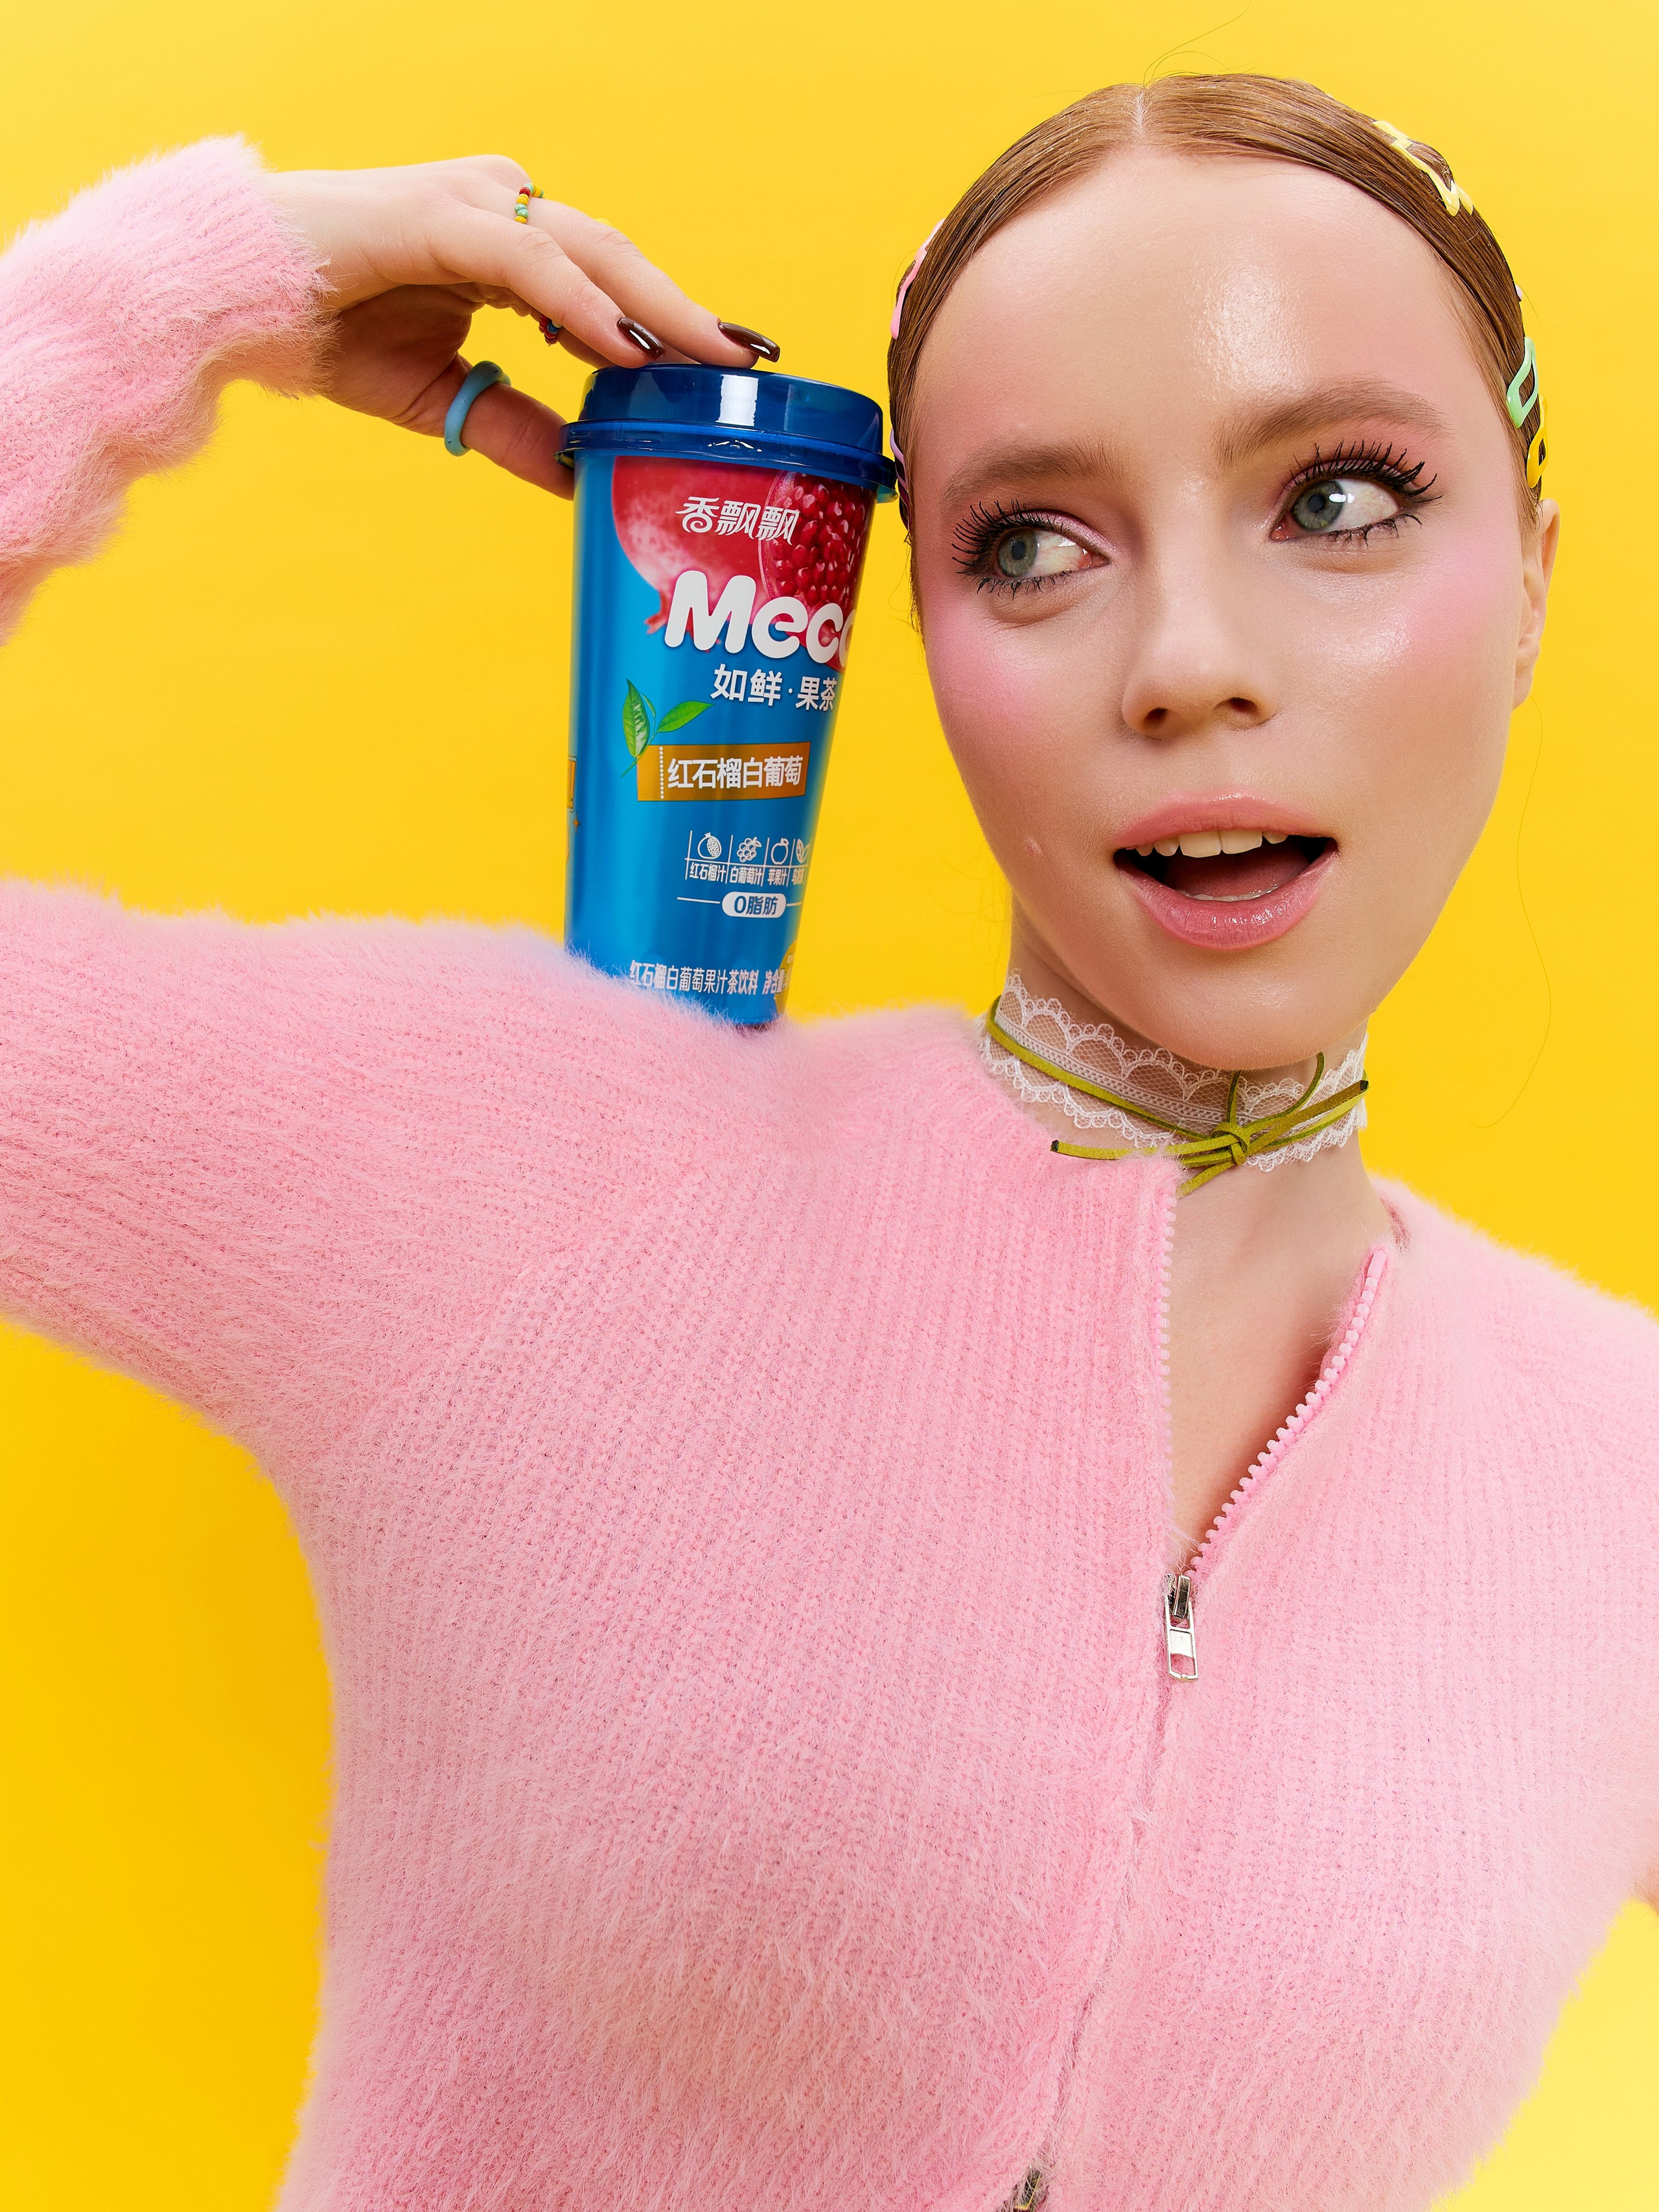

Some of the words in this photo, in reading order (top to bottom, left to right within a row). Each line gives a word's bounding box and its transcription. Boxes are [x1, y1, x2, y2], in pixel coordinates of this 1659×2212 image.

[675, 496, 800, 545] 香飘飘
[667, 755, 803, 789] 红石榴白葡萄
[689, 862, 726, 882] 红石榴汁
[729, 866, 763, 885] 白葡萄汁
[767, 868, 787, 886] 苹果汁
[734, 895, 778, 915] 0脂肪
[629, 959, 760, 995] 红石榴白葡萄果汁茶饮料
